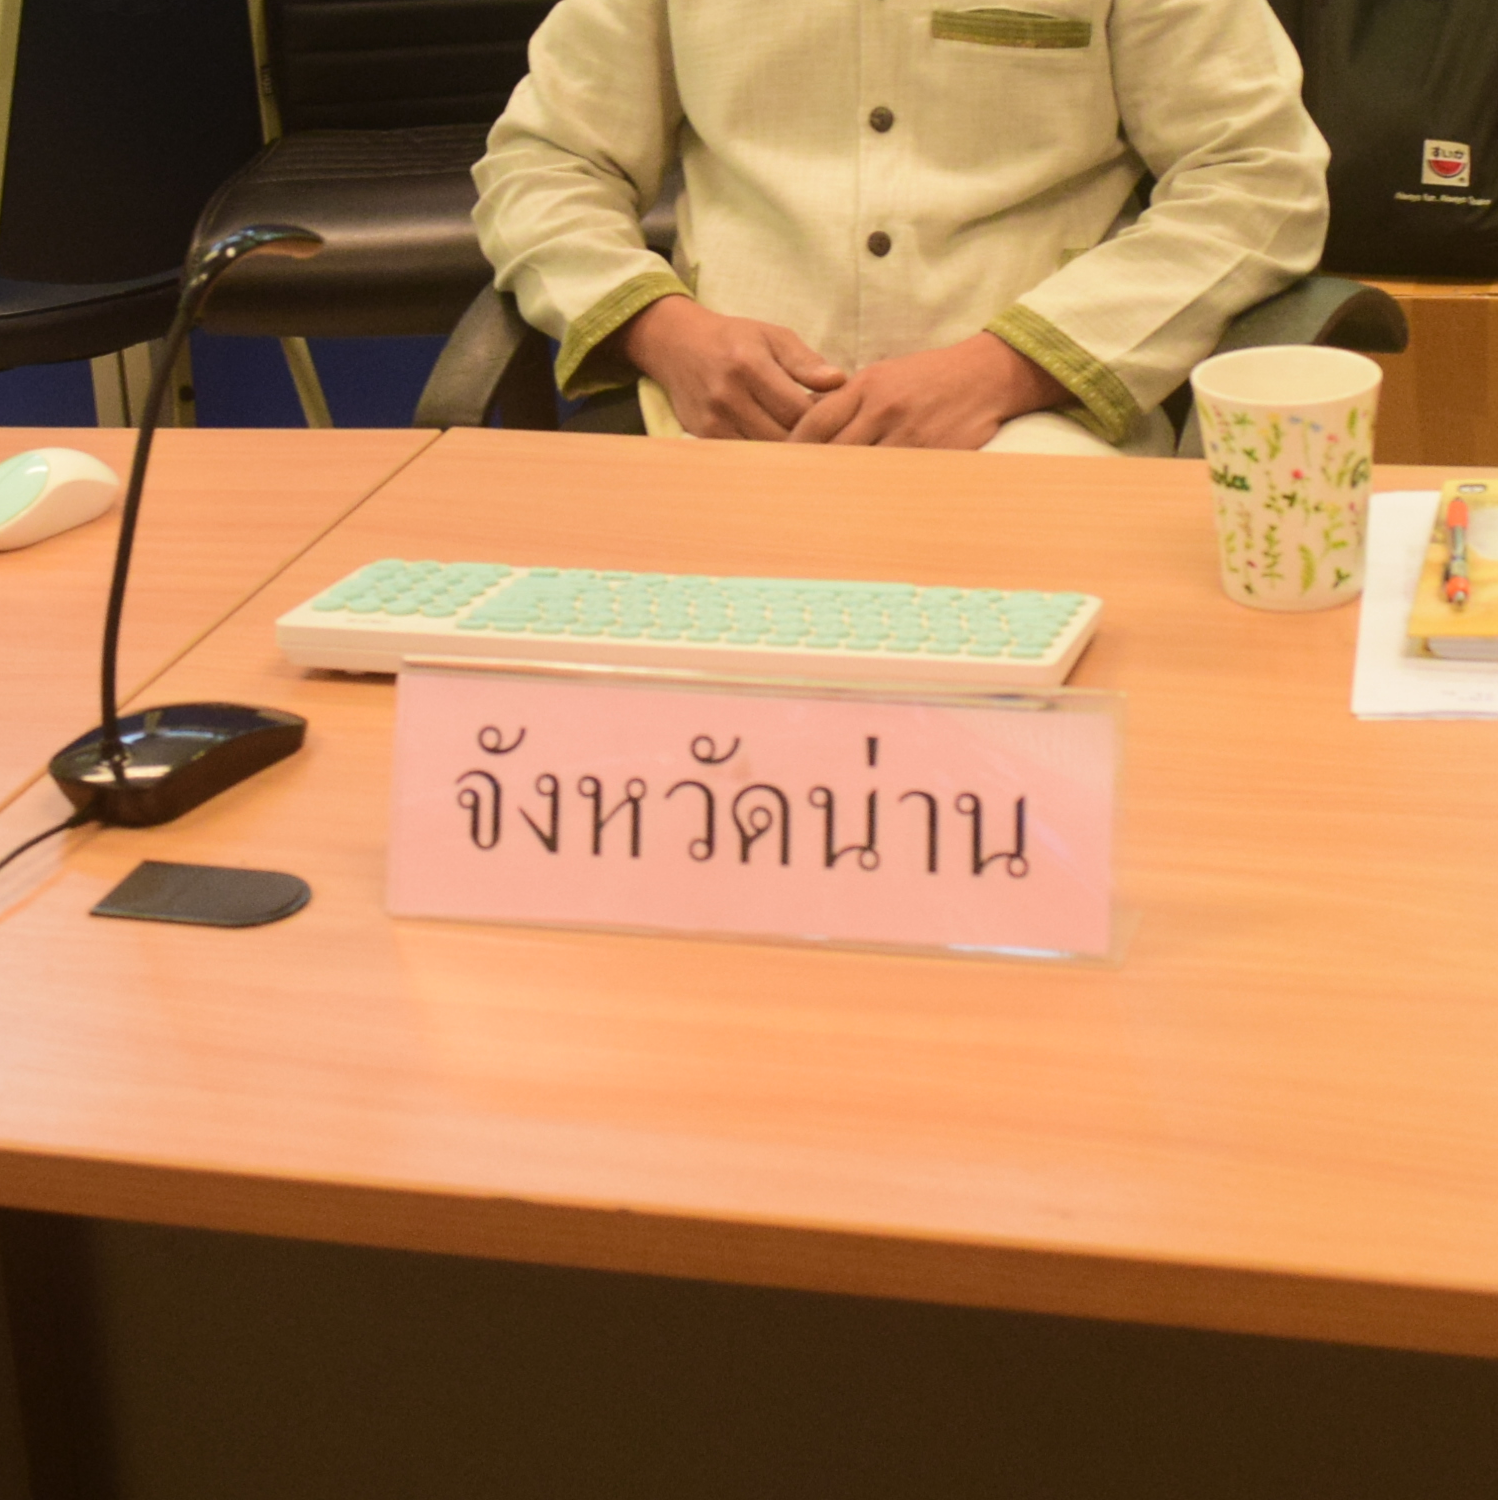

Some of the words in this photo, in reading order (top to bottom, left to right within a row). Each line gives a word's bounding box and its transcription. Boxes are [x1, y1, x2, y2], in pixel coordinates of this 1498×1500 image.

[454, 725, 1030, 879] จังหวัดน่าน
